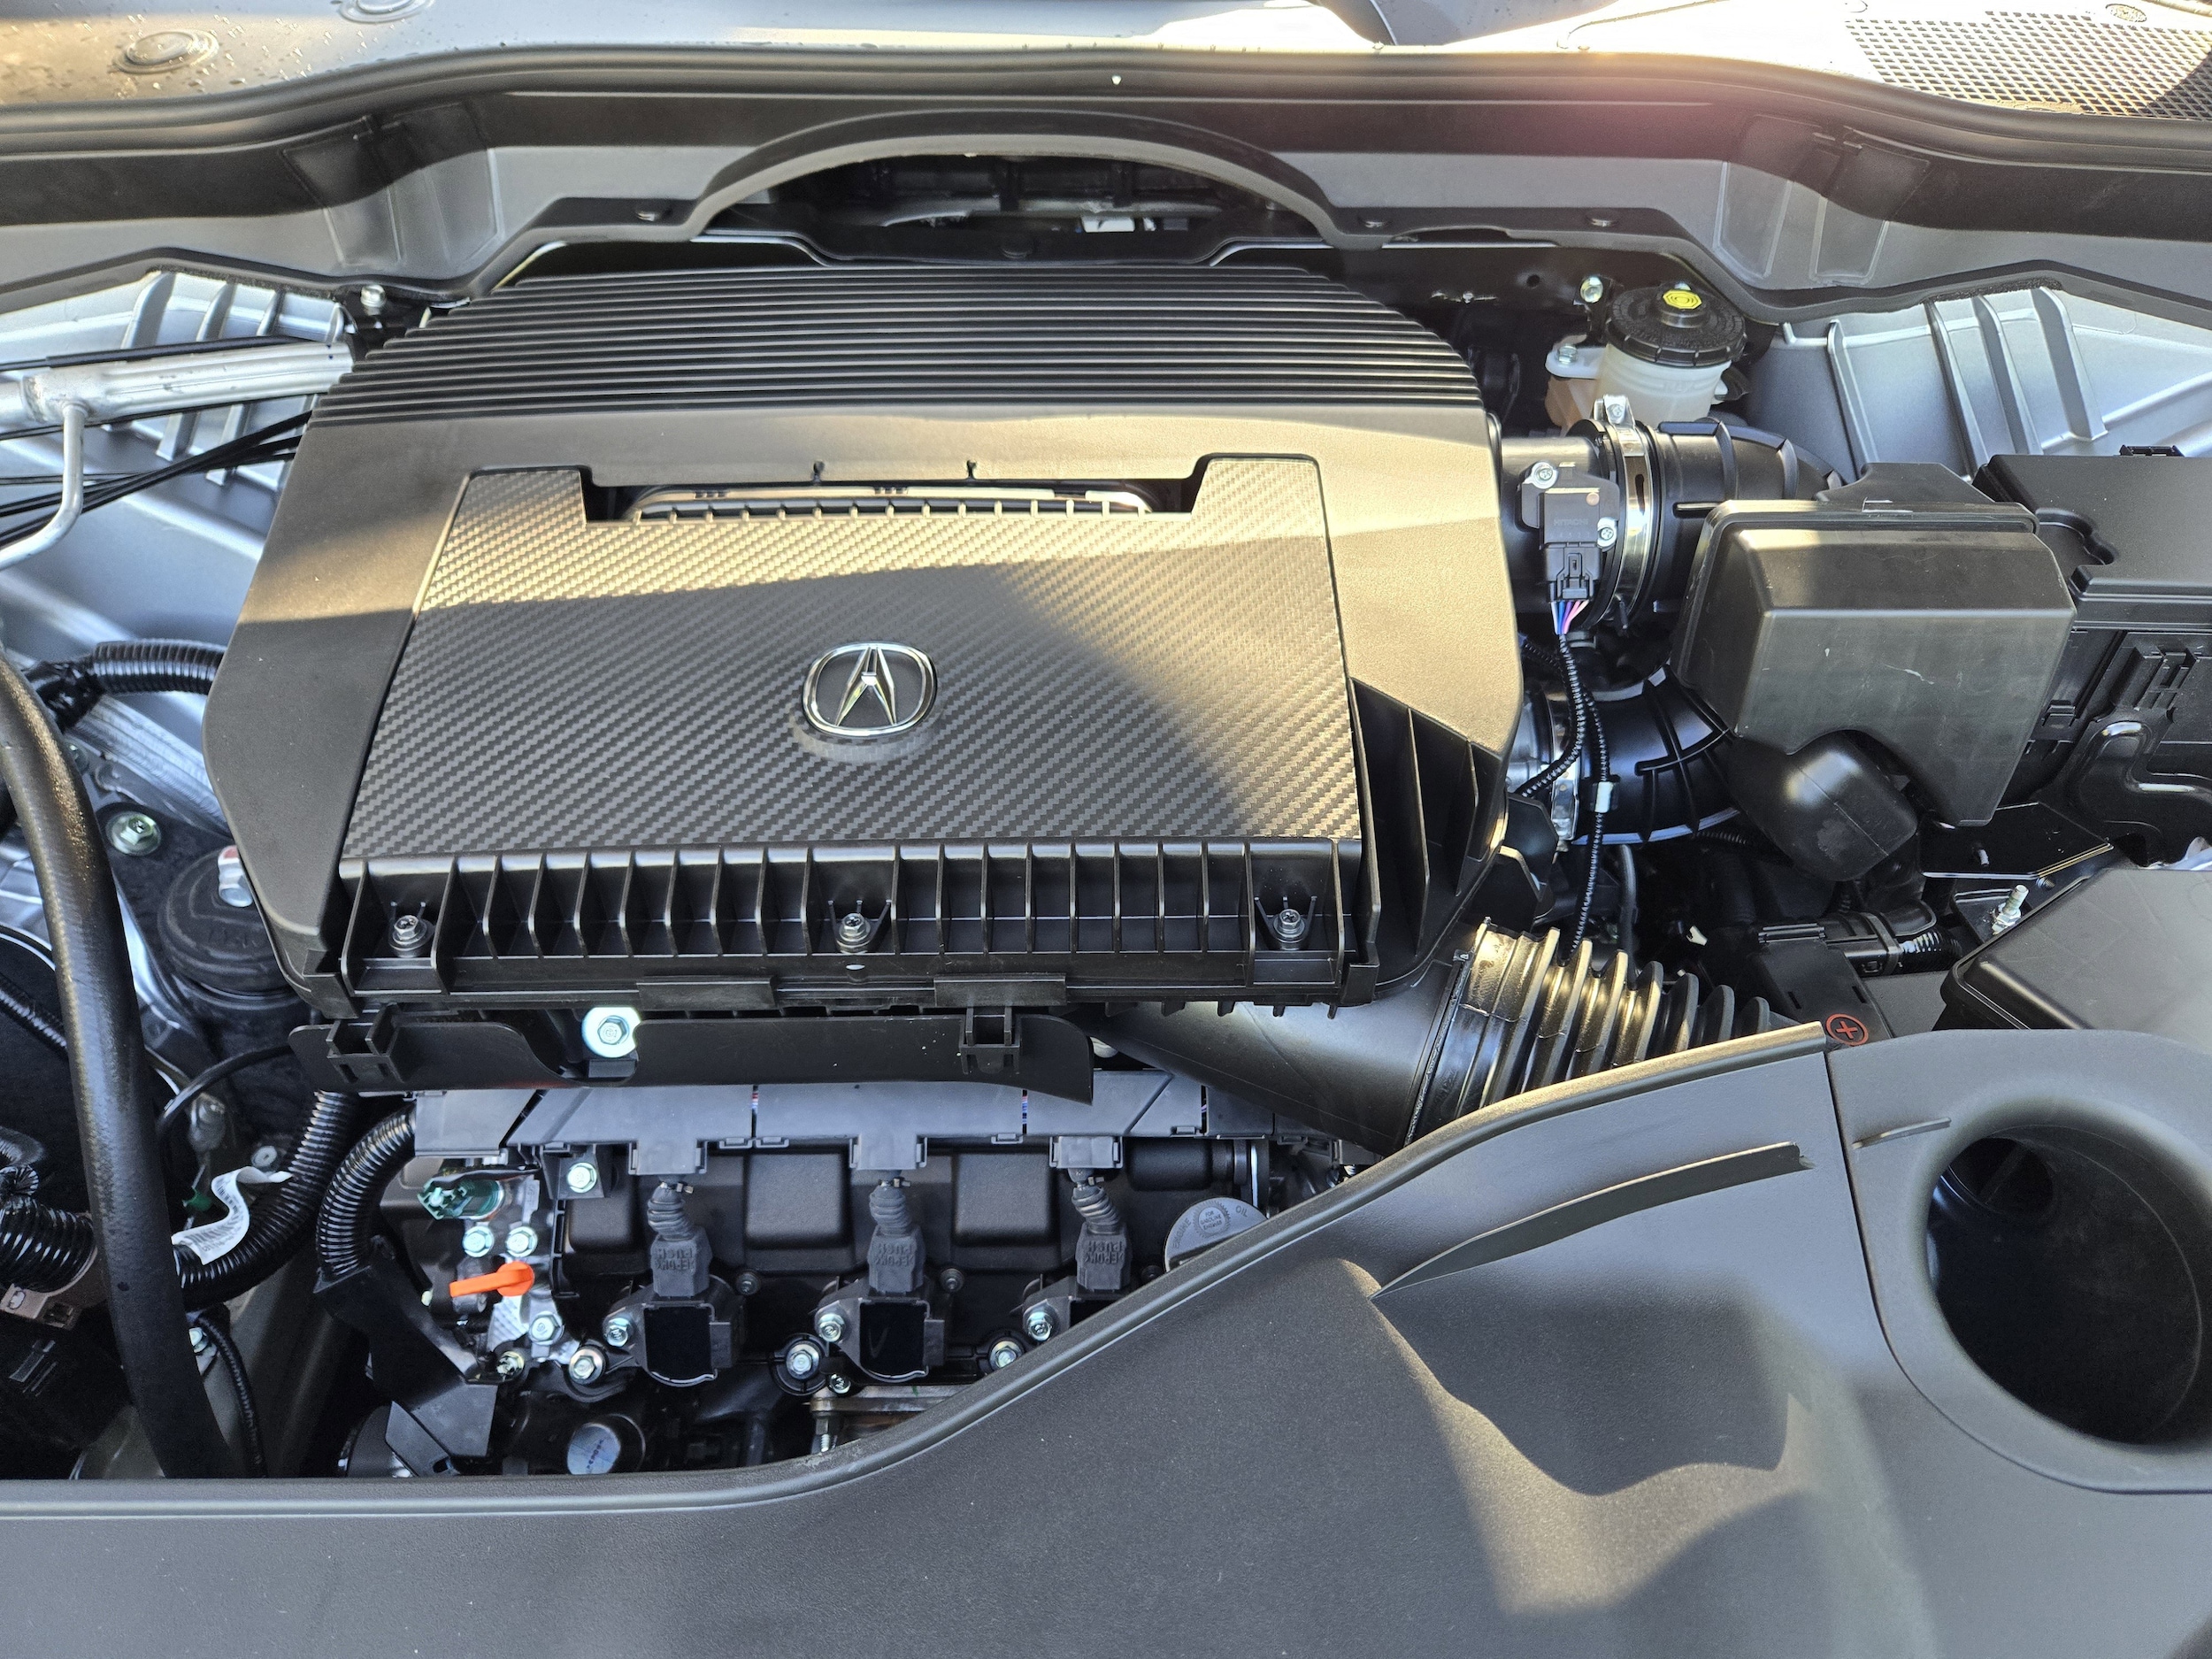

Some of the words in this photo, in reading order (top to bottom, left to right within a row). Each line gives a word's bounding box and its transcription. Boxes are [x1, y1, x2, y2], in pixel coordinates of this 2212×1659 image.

[1172, 1217, 1192, 1248] ENGINE
[1235, 1205, 1248, 1217] OIL
[1200, 1213, 1223, 1225] GASOLINE
